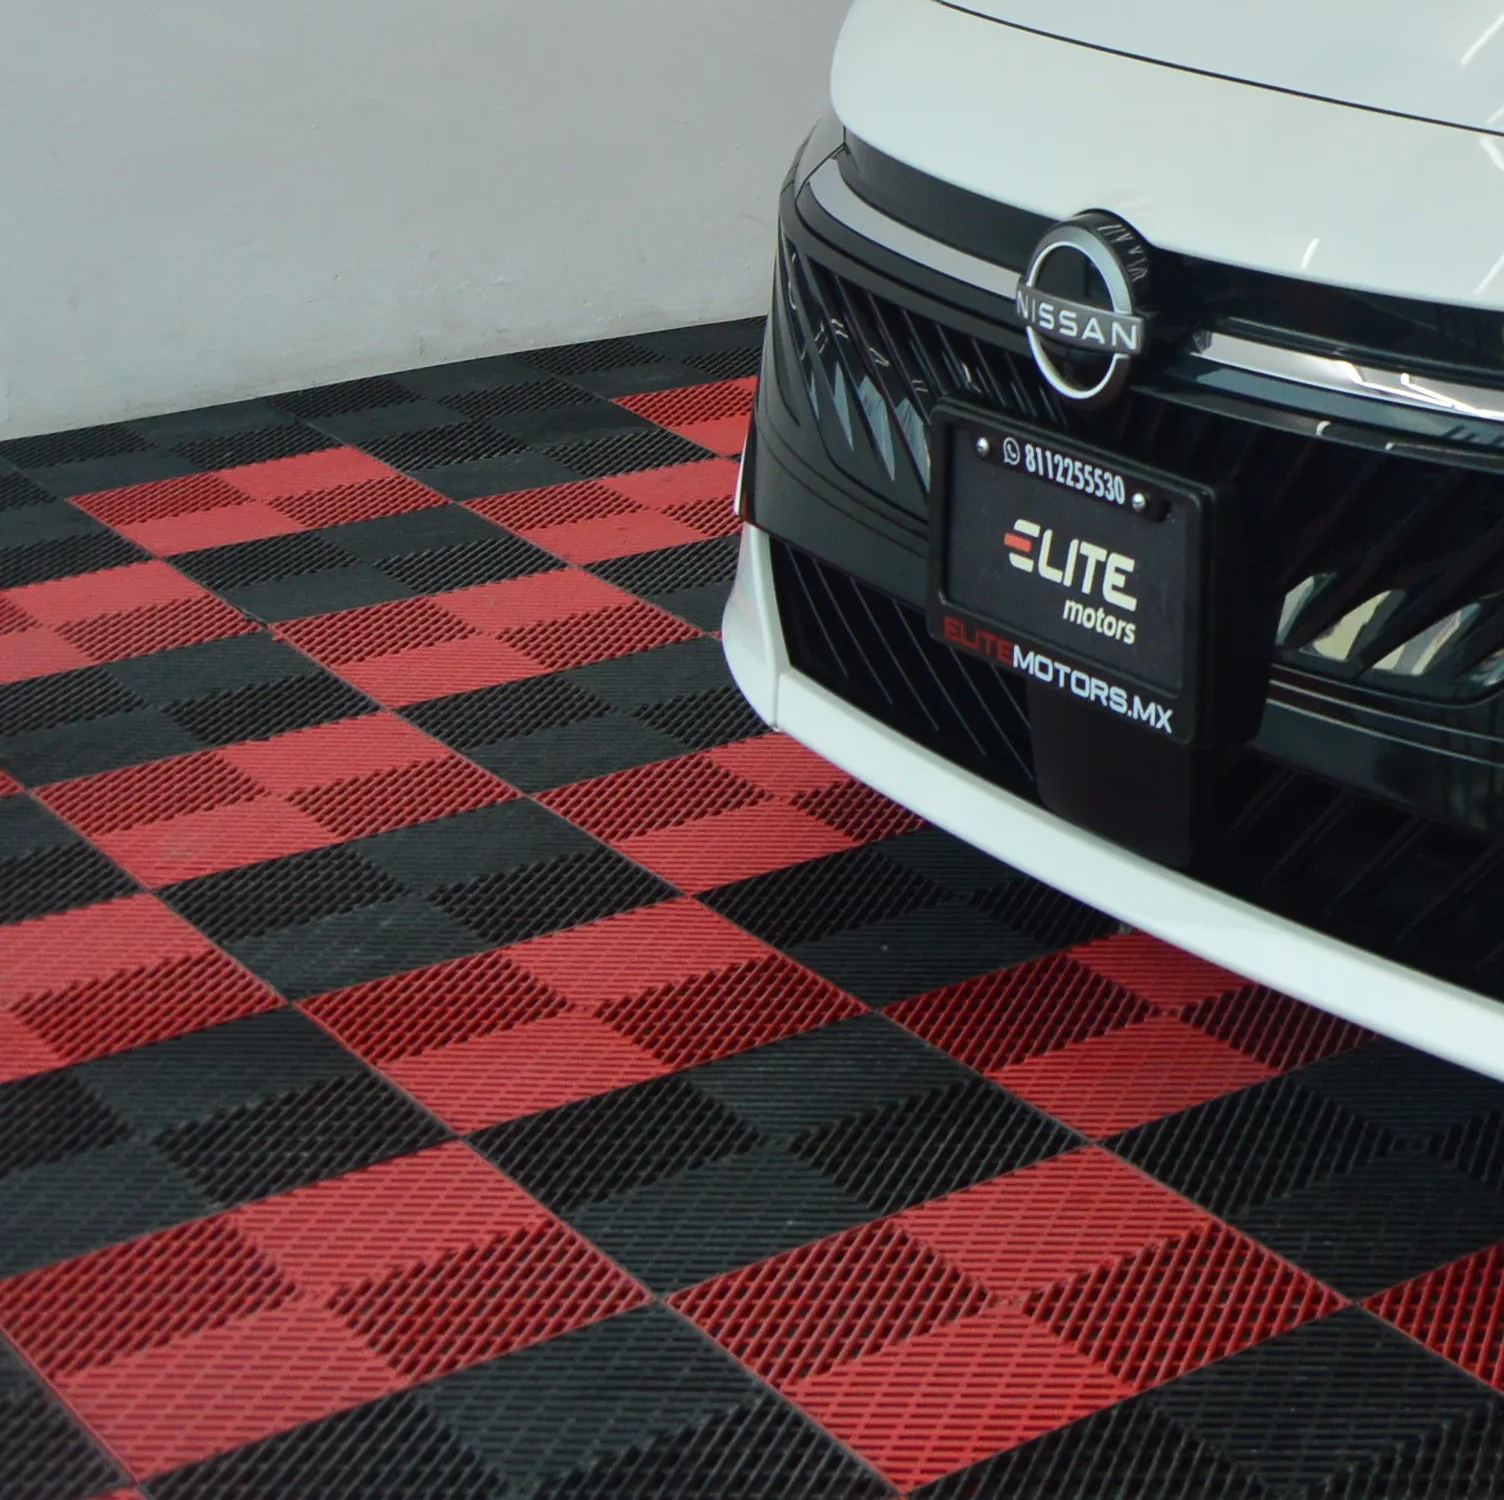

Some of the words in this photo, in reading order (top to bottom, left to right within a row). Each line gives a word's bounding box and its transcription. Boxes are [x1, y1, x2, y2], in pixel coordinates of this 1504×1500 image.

[1015, 290, 1140, 352] NISSAN
[1024, 443, 1126, 505] 8112255530
[1003, 518, 1138, 612] ELITE
[1062, 595, 1137, 645] motors
[943, 614, 1173, 733] ELITEMOTORS.MX
